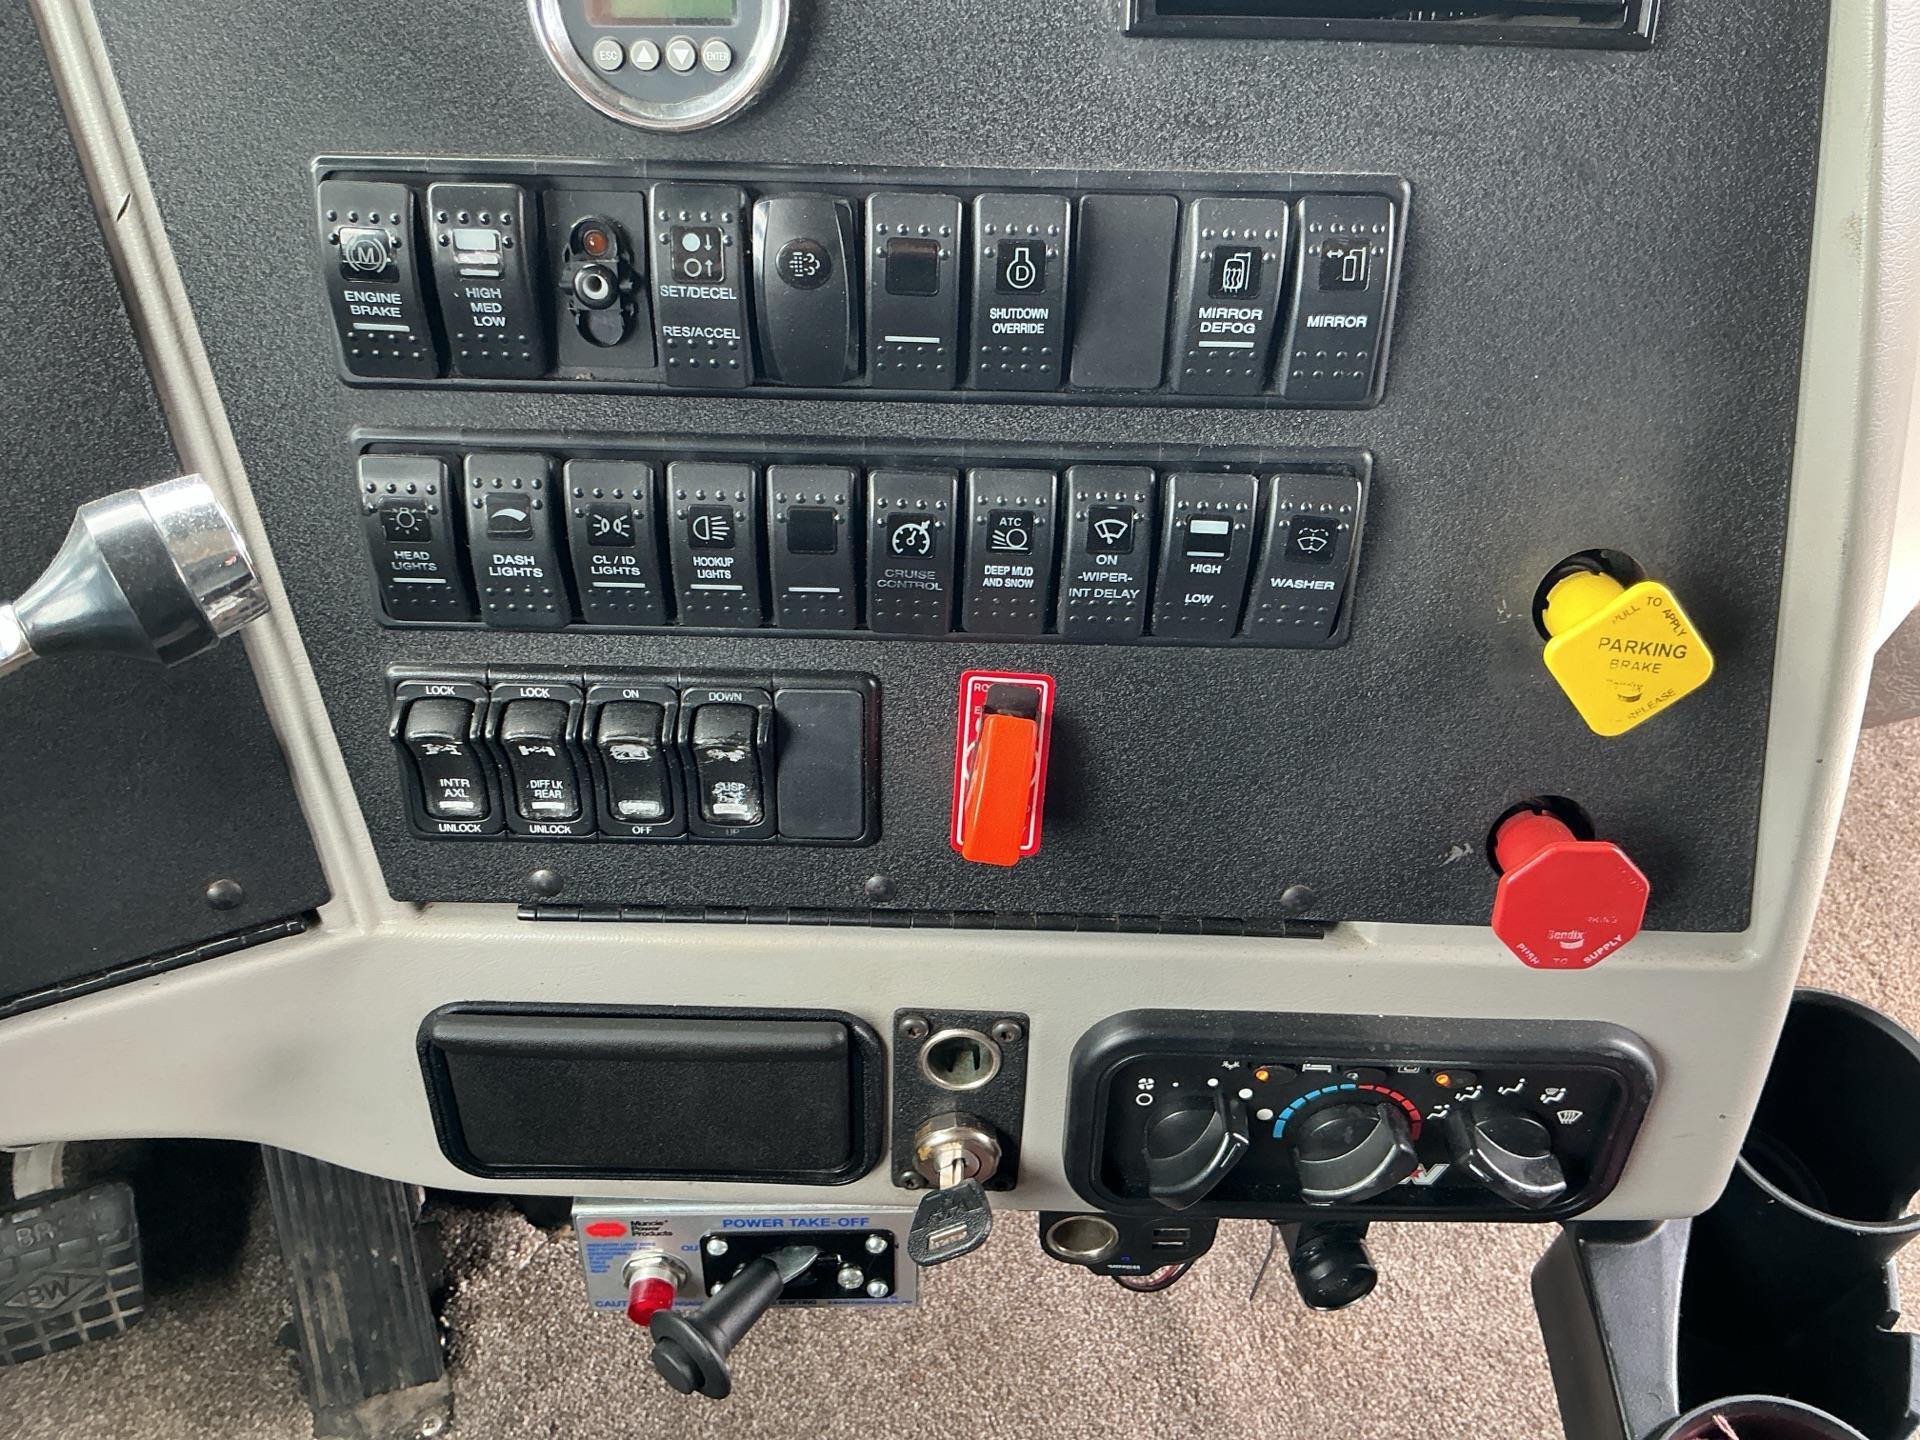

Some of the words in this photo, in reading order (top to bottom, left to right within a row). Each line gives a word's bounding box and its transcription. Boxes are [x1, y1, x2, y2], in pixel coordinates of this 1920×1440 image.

[600, 50, 617, 61] ESC
[706, 51, 729, 62] ENTER
[344, 291, 402, 306] ENGINE
[465, 287, 502, 299] HIGH
[659, 285, 737, 300] SET/DECEL
[350, 304, 402, 318] BRAKE
[470, 301, 502, 313] MED
[989, 307, 1049, 320] SHUTDOWN
[1198, 307, 1263, 321] MIRROR
[473, 316, 506, 328] LOW
[1199, 321, 1256, 334] DEFOG
[1306, 315, 1368, 328] MIRROR
[662, 325, 741, 340] RES/ACCEL
[992, 322, 1045, 334] OVERRIDE
[999, 516, 1022, 527] ATC
[394, 550, 430, 561] HEAD
[493, 554, 535, 566] DASH
[1095, 554, 1118, 566] ON
[391, 561, 438, 572] LIGHTS
[692, 556, 735, 568] HOOKUP
[488, 566, 544, 578] LIGHTS
[590, 566, 641, 576] LIGHTS
[697, 568, 732, 579] LIGHTS
[884, 568, 936, 580] CRUISE
[984, 564, 1008, 576] DEEP
[1010, 565, 1034, 576] MUD
[1189, 563, 1222, 575] HIGH
[982, 577, 1002, 588] AND
[1003, 577, 1034, 588] SNOW
[1077, 571, 1133, 583] -WIPER-
[876, 579, 943, 591] CONTROL
[1270, 577, 1335, 591] WASHER
[1068, 587, 1090, 598] INT
[1092, 587, 1140, 600] DELAY
[1184, 593, 1214, 604] LOW
[1646, 596, 1663, 607] TO
[1662, 608, 1688, 637] APPLY
[1598, 637, 1688, 659] PARKING
[1609, 658, 1662, 674] BRAKE
[425, 686, 456, 696] LOCK
[520, 687, 550, 698] LOCK
[622, 689, 639, 699] ON
[708, 691, 742, 701] DOWN
[439, 778, 470, 788] INTR
[530, 779, 550, 789] DIFF
[551, 780, 564, 789] LK
[714, 781, 746, 792] SUSP
[444, 788, 470, 798] AXL
[534, 789, 562, 799] REAR
[438, 823, 482, 833] UNLOCK
[529, 824, 572, 834] UNLOCK
[631, 825, 652, 835] OFF
[725, 828, 740, 837] UP
[1583, 934, 1624, 964] SUPPLY
[722, 1217, 785, 1228] POWER
[788, 1216, 870, 1227] TAKE-OFF
